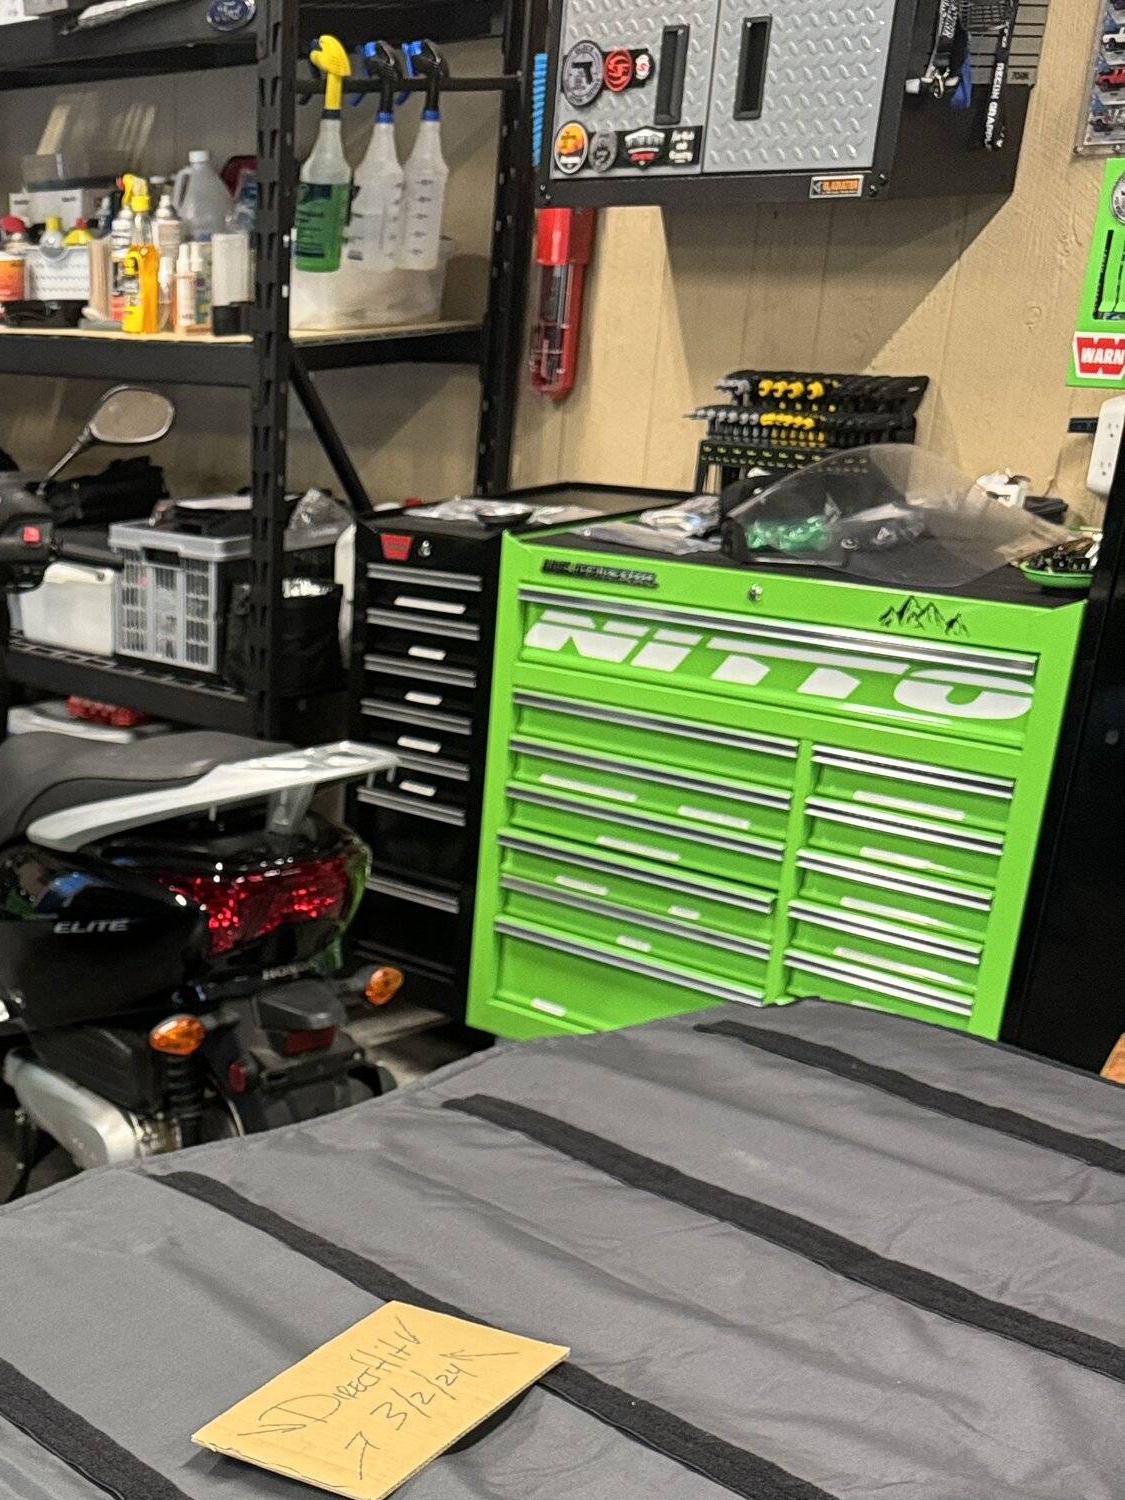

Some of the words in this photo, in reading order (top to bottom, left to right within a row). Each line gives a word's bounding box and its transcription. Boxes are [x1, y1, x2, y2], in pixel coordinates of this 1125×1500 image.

[1081, 346, 1125, 365] WARN
[524, 608, 1036, 720] NITTO
[54, 918, 130, 934] ELITE
